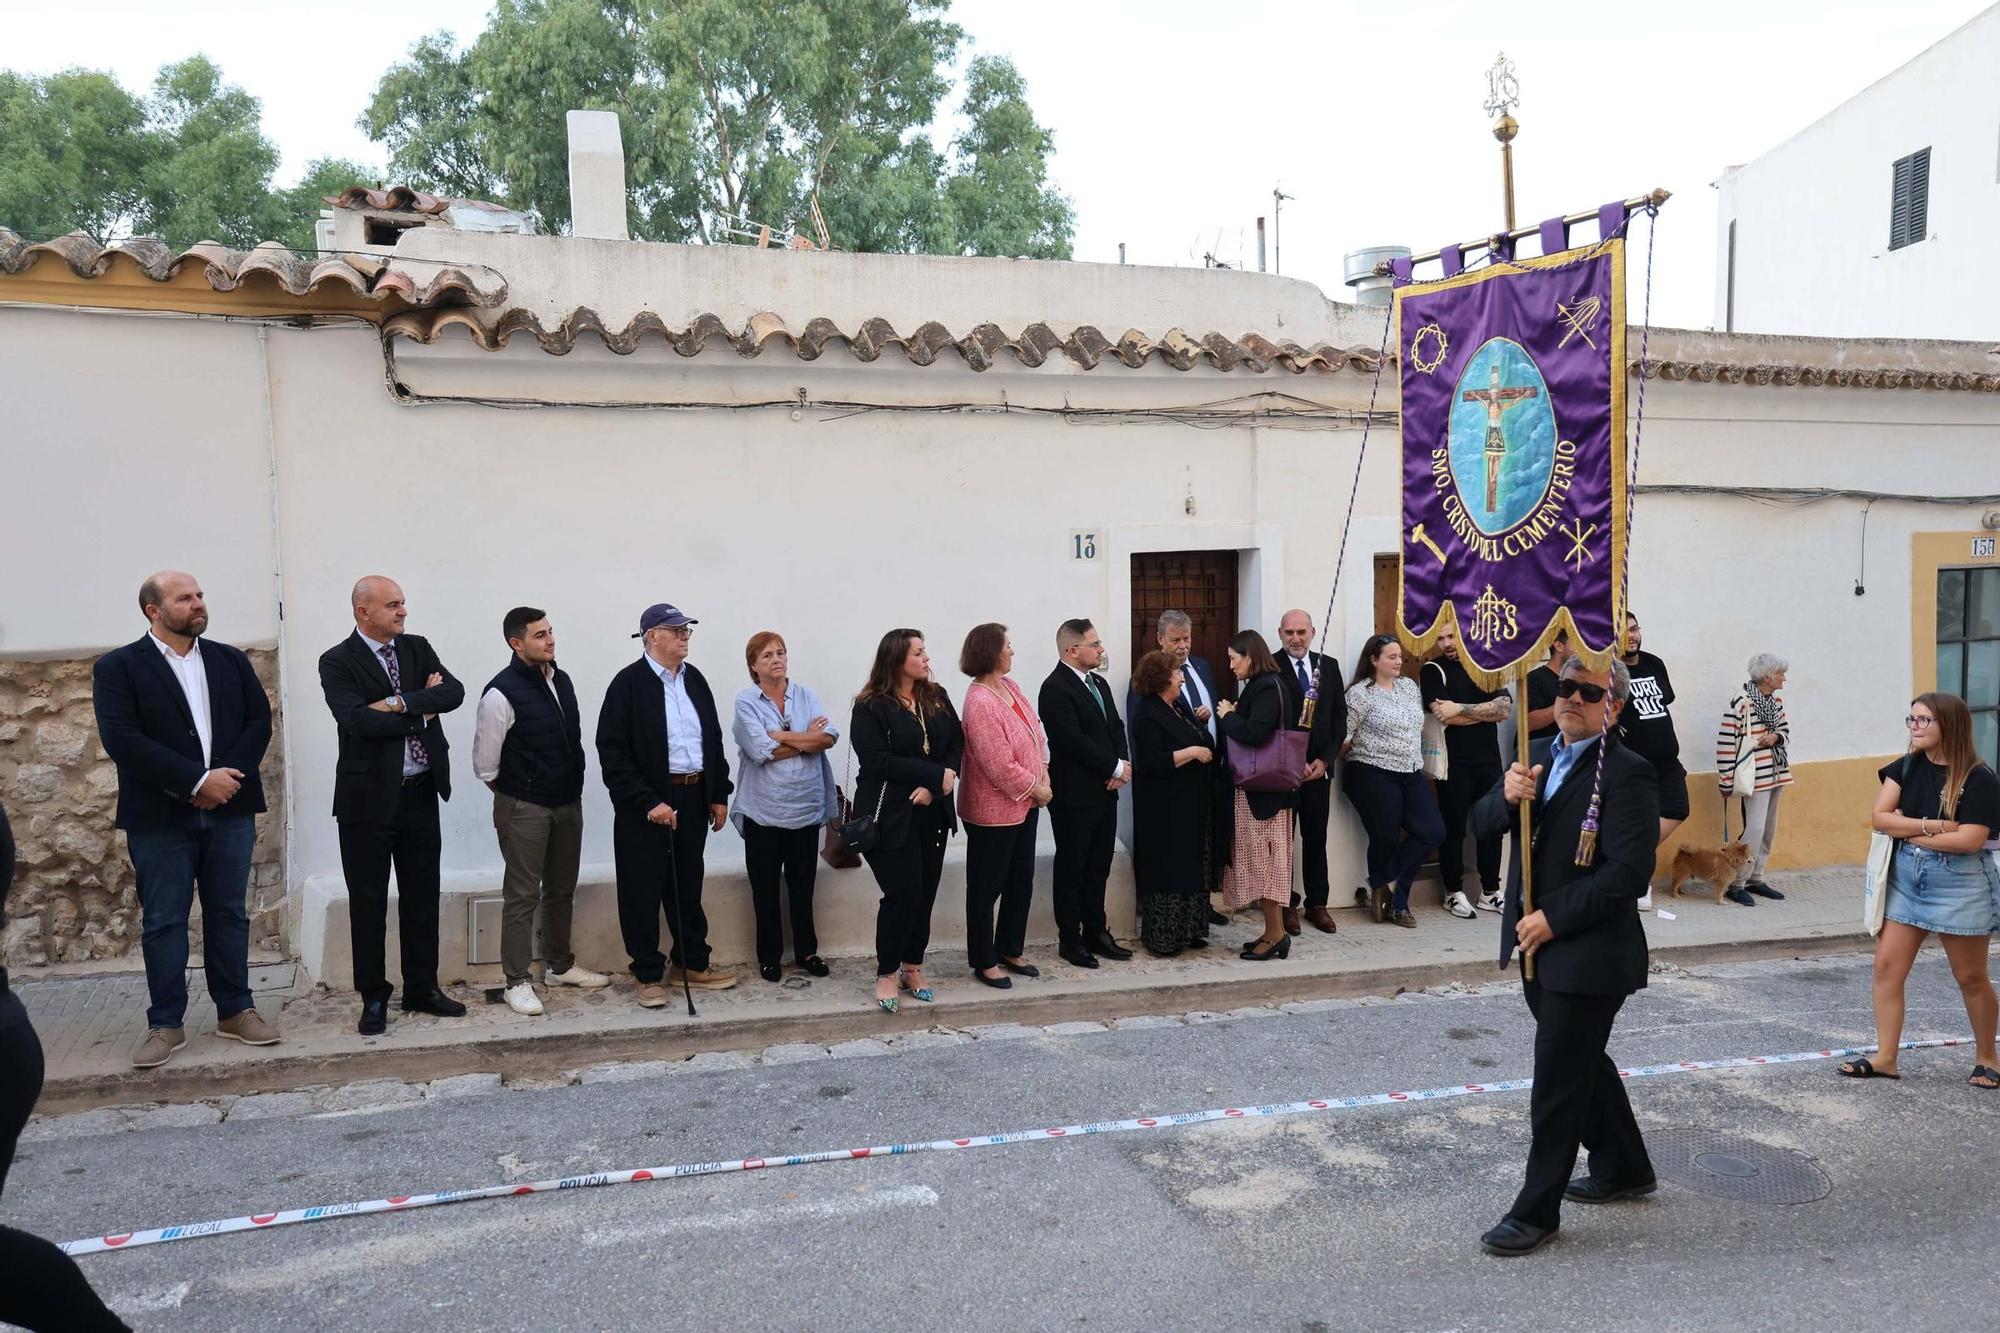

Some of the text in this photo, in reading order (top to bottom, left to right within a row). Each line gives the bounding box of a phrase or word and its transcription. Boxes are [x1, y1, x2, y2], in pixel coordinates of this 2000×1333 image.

[1431, 440, 1577, 562] SMO. CRISTO DEL CEMENTERIO
[1074, 534, 1096, 559] 13
[1629, 680, 1663, 698] WRK
[1633, 695, 1664, 715] OUT
